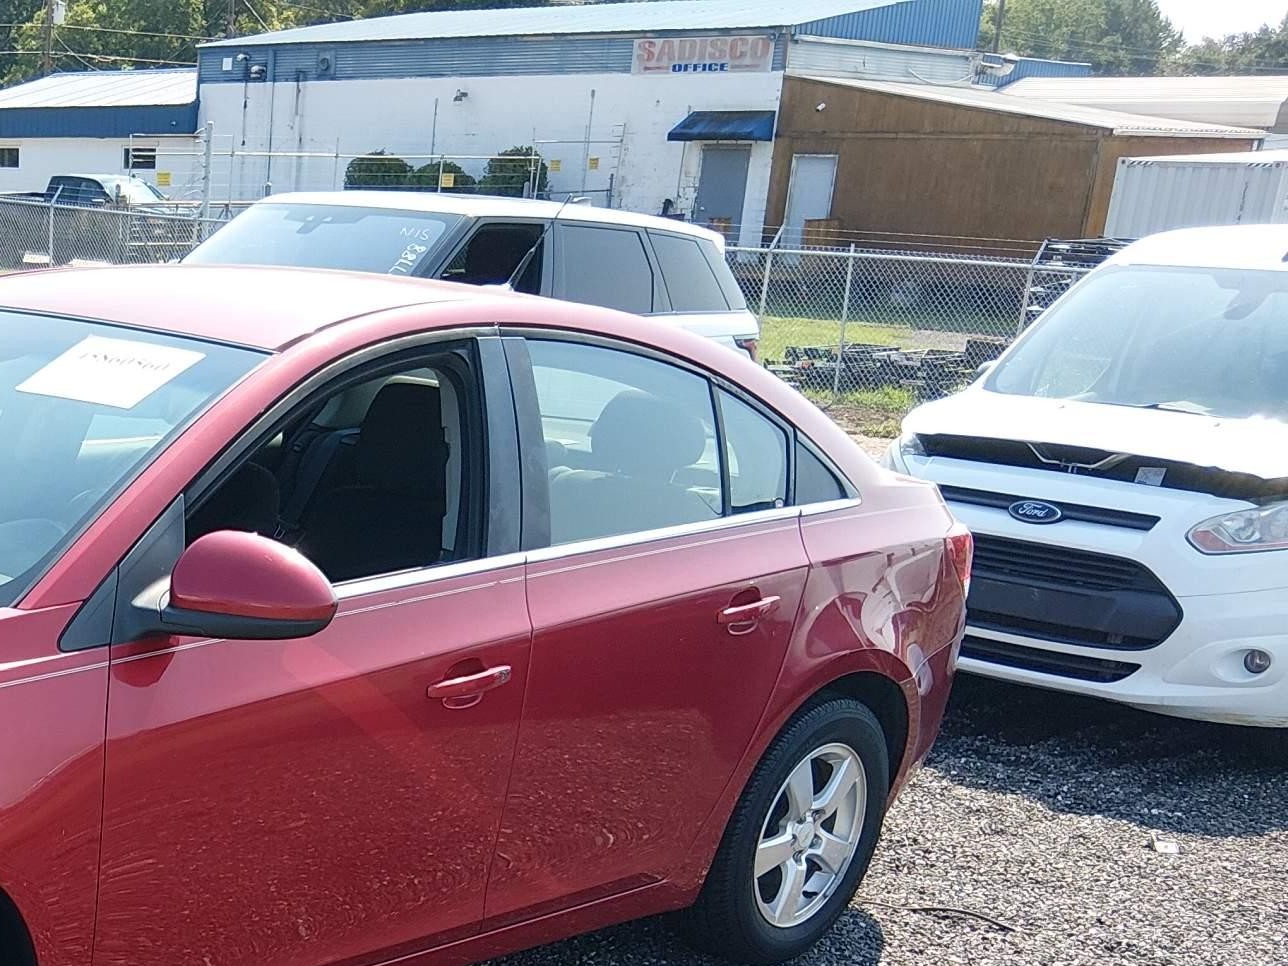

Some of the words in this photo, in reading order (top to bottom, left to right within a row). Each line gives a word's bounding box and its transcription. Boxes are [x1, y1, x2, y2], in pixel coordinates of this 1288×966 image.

[637, 38, 771, 62] SADISCO
[672, 62, 729, 72] OFFICE
[1018, 502, 1048, 517] Ford
